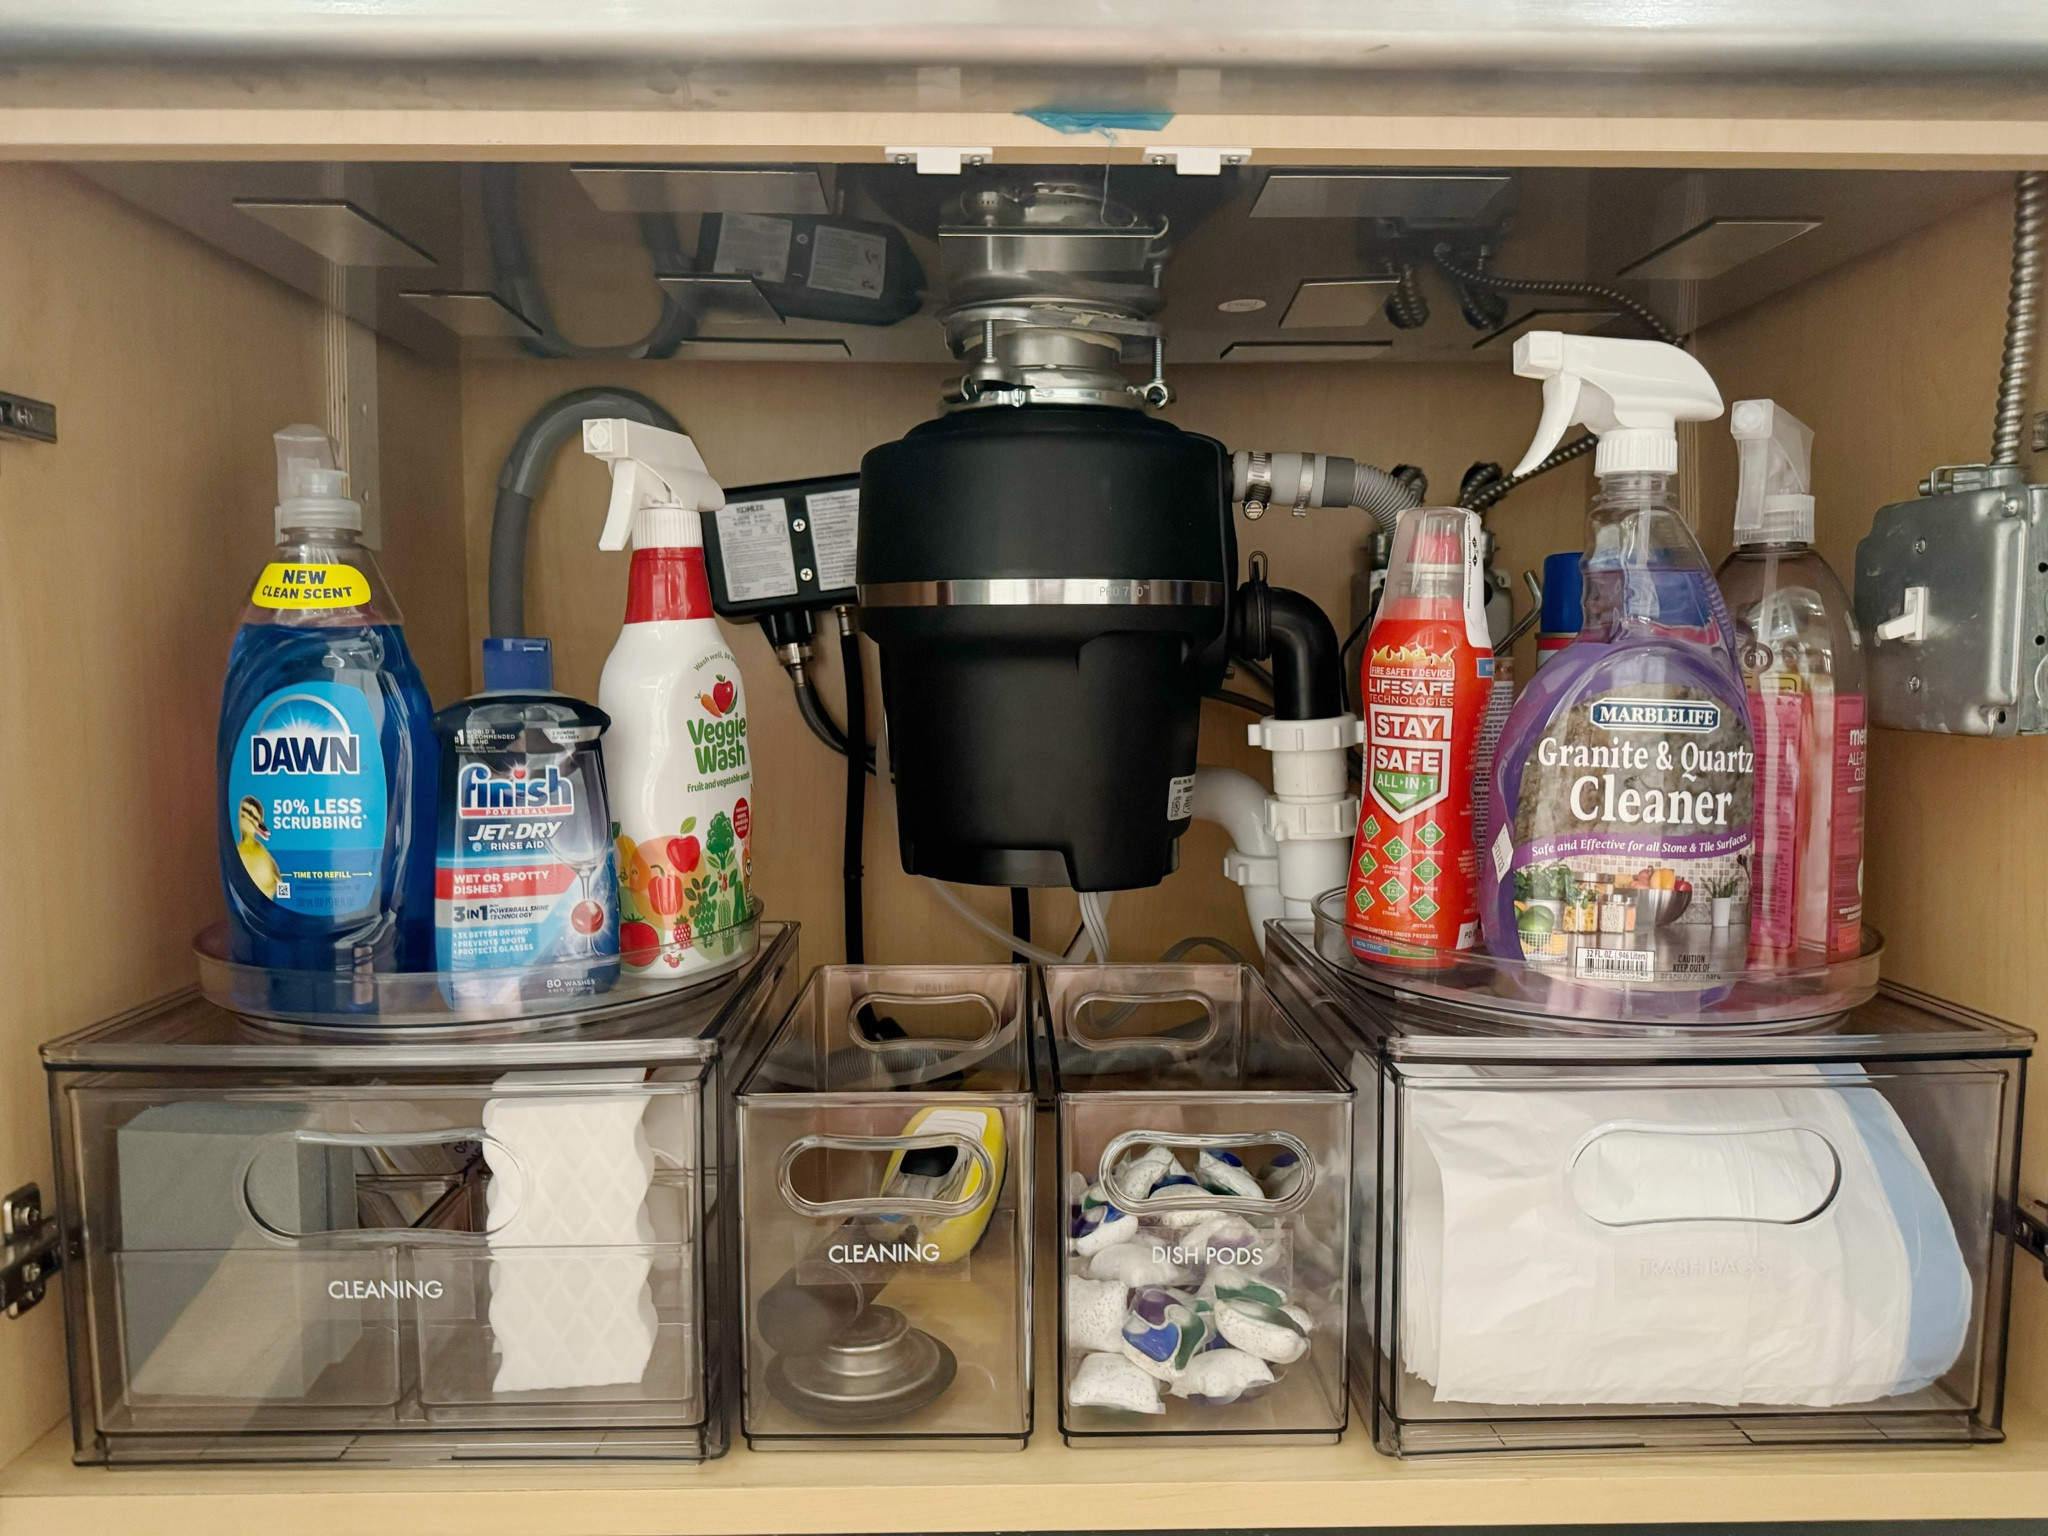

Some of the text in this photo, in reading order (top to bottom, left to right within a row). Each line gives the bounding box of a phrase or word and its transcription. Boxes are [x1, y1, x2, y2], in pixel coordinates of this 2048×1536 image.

[282, 569, 327, 585] NEW
[262, 585, 352, 599] CLEAN SCENT
[1371, 666, 1451, 678] FIRE SAFETY DEVICE
[1368, 678, 1454, 697] LIFESAFE
[1369, 694, 1454, 707] TECHNOLOGIES
[1599, 705, 1714, 725] MARBLELIFE
[686, 712, 746, 748] Veggie
[1376, 714, 1441, 739] STAY
[252, 735, 359, 773] DAWN
[694, 739, 746, 775] Wash
[1376, 747, 1440, 773] SAFE
[1537, 737, 1754, 782] Granite & Quartz
[459, 763, 574, 808] finish
[687, 781, 704, 793] Fruit
[704, 779, 717, 790] and
[273, 798, 362, 815] 50% LESS
[1570, 773, 1733, 826] Cleaner
[485, 807, 550, 816] POWERBALL
[273, 816, 362, 829] SCRUBBING
[467, 821, 563, 841] JET-DRY
[490, 841, 545, 851] RINSE AID
[1532, 833, 1747, 857] Safe and Effective for all Stone & Tile Surfaces
[293, 870, 352, 879] TIME TO REFILL
[454, 870, 550, 884] WET OR SPOTTY
[453, 884, 503, 895] DISHES?
[489, 906, 529, 914] POWERBALL
[490, 912, 533, 920] TECHNOLOGY
[468, 930, 498, 939] BETTER
[458, 939, 498, 947] PREVENTS
[458, 943, 534, 956] PROTECTS GLASSES
[1594, 950, 1603, 958] FL.
[1604, 950, 1613, 958] OZ.
[1677, 954, 1706, 964] CAUTION
[1672, 963, 1710, 972] KEEP OUT OF
[546, 979, 596, 988] 80 WASHES
[828, 1243, 940, 1264] CLEANING
[1151, 1245, 1265, 1266] DISH PODS
[328, 1279, 444, 1300] CLEANING
